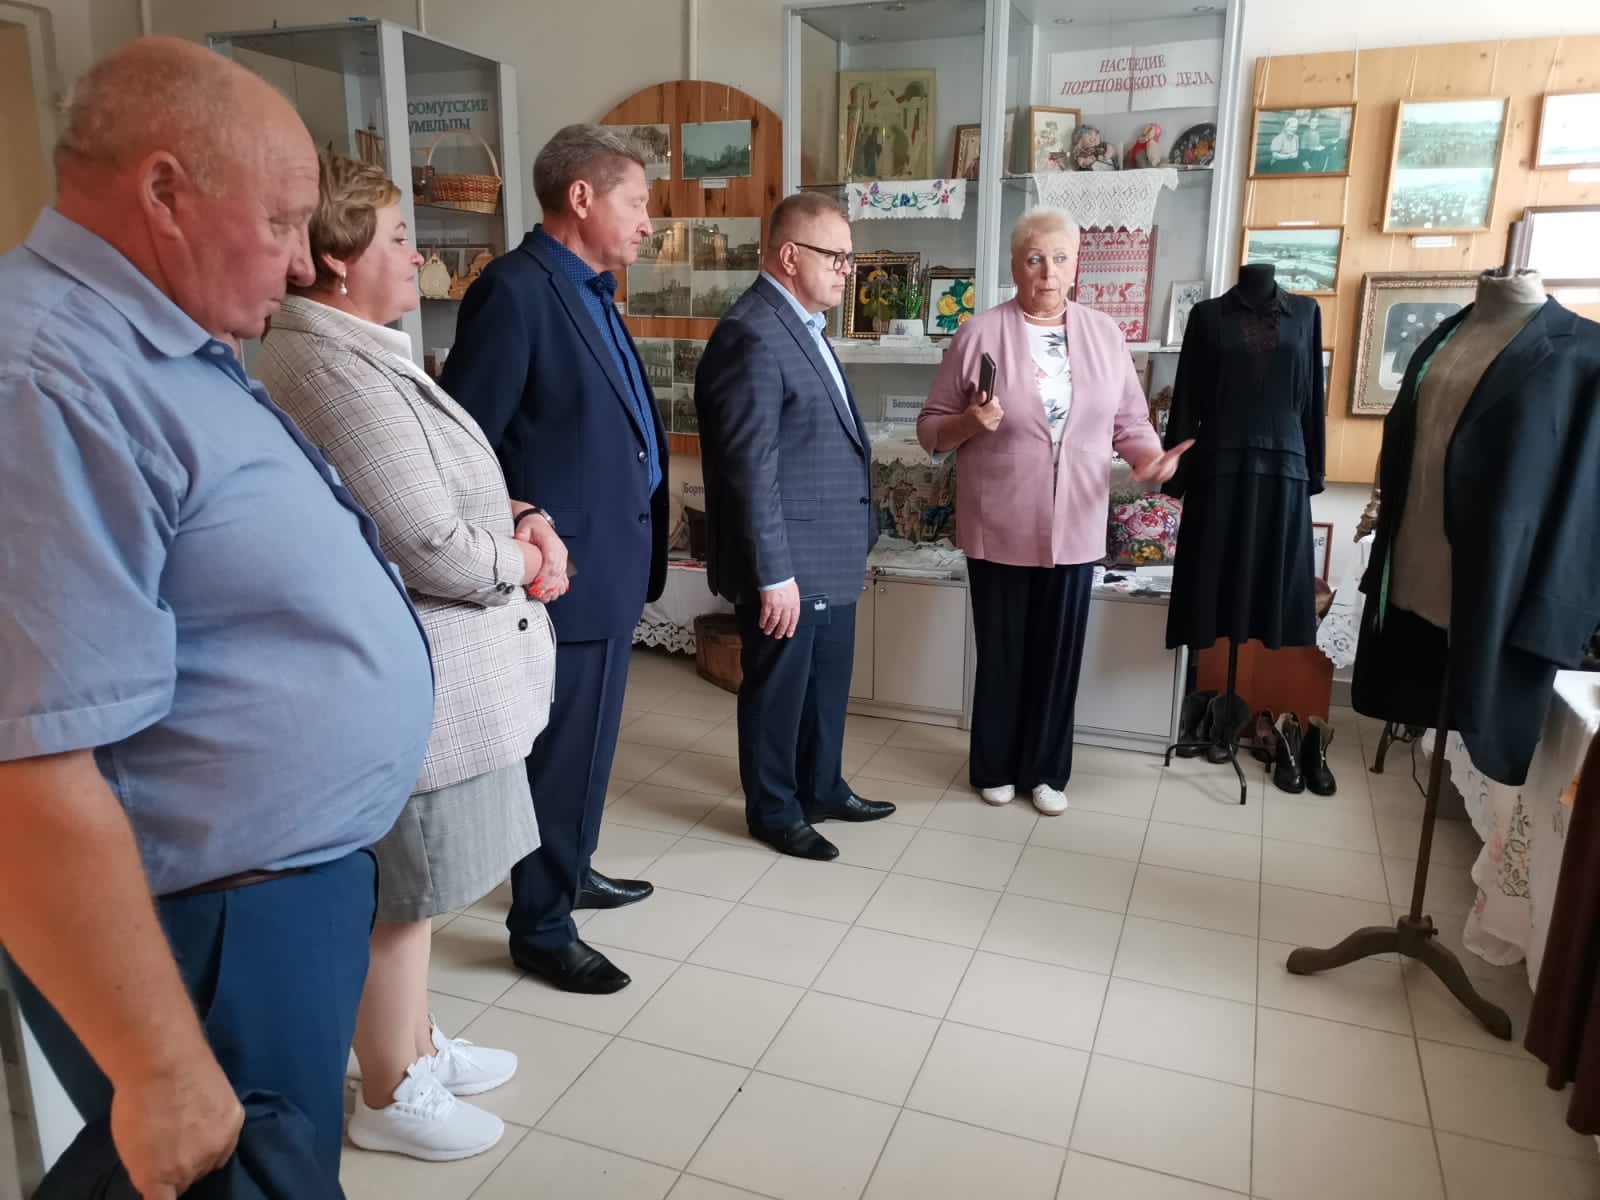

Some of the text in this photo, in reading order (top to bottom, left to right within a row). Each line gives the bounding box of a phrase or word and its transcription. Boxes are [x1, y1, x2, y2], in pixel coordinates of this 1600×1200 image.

[1099, 55, 1166, 73] НАСЛЕДИЕ
[1060, 71, 1213, 96] ПОРТНОВСКОГО ДЕЛА
